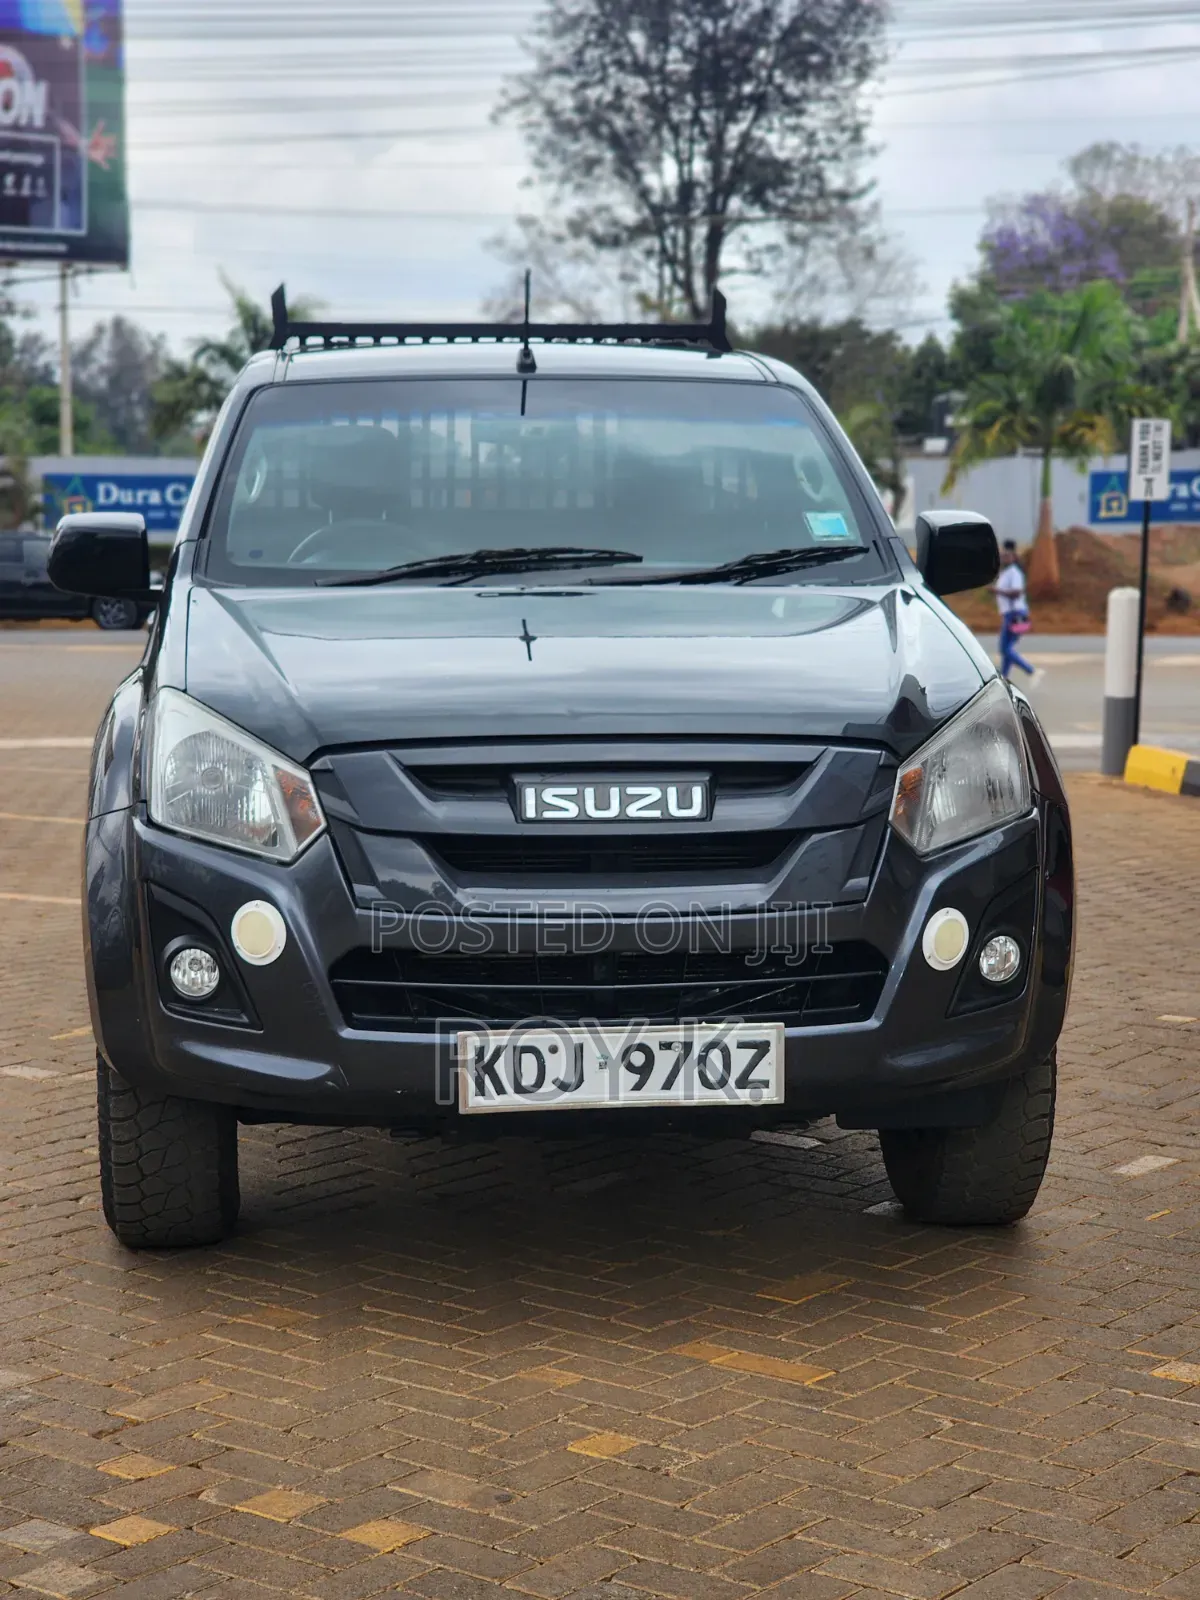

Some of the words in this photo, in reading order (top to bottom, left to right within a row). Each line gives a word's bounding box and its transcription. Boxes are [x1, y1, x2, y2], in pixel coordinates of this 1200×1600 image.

[97, 482, 161, 506] Dura
[525, 786, 702, 819] ISUZU
[474, 1042, 584, 1097] KDJ
[621, 1039, 771, 1092] 970Z
